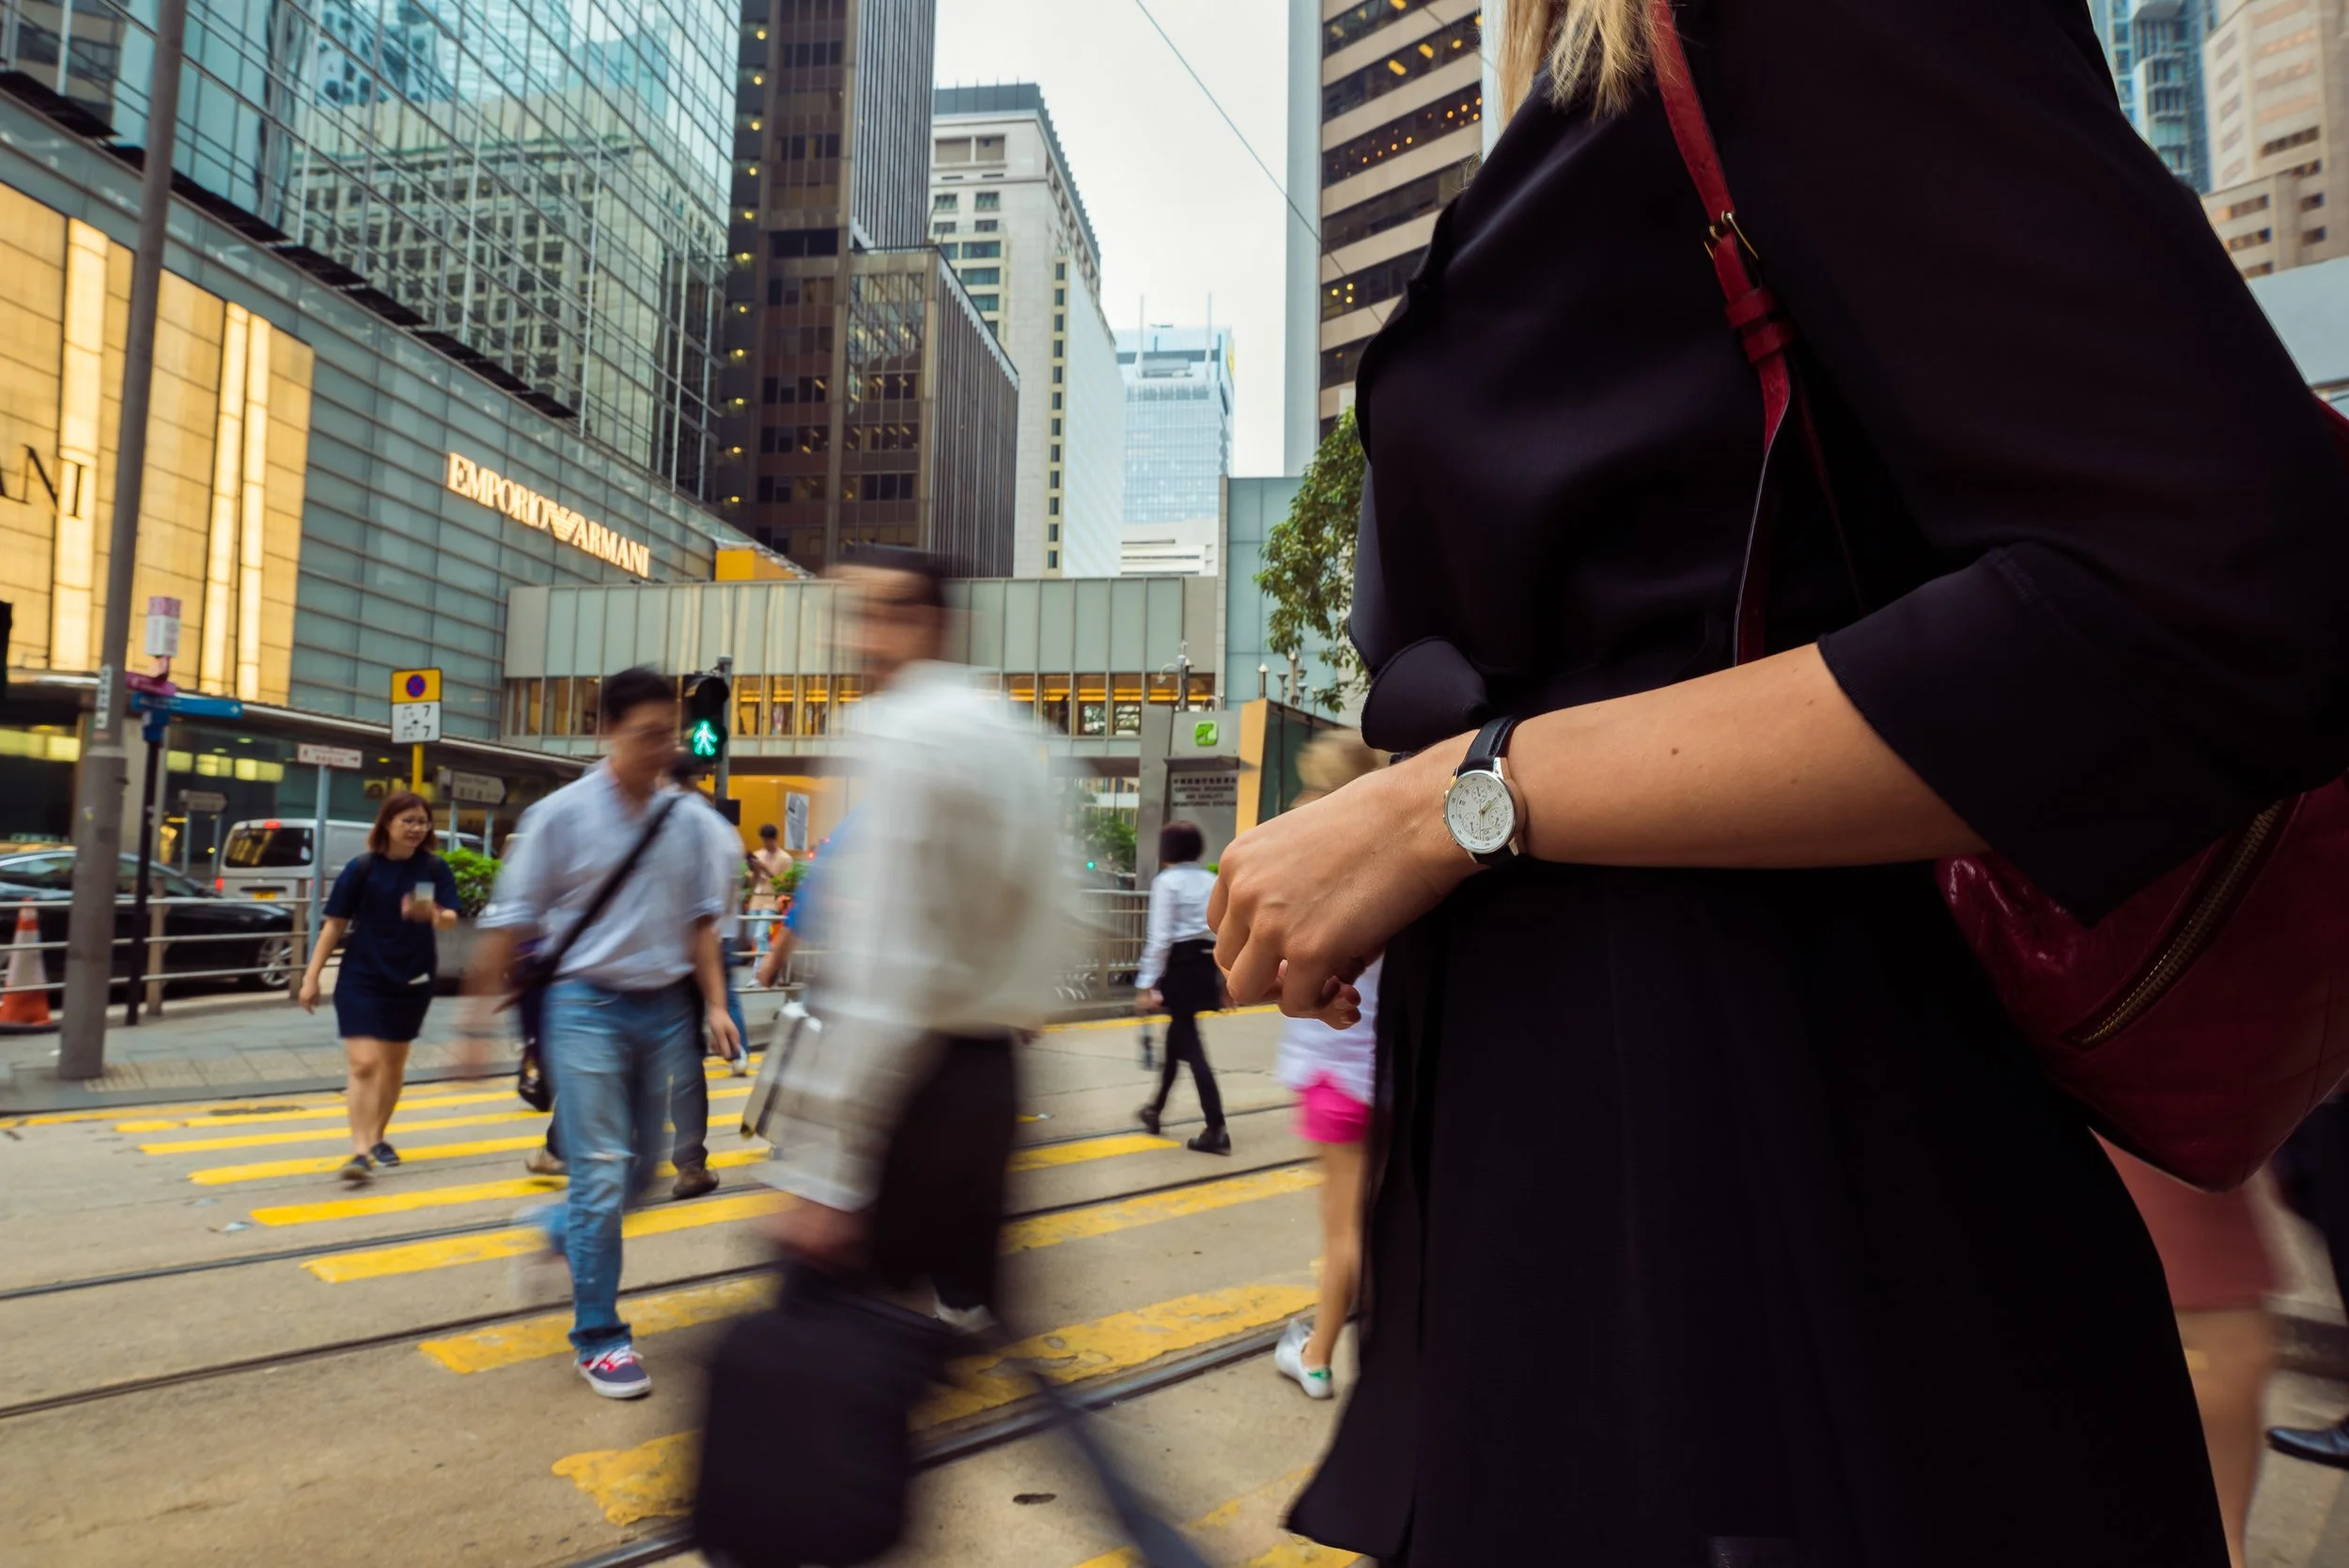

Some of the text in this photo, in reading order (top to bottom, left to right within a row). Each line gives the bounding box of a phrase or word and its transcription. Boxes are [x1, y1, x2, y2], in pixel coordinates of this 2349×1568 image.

[0, 443, 88, 520] NI
[447, 451, 650, 579] EMPORIO ARMANI
